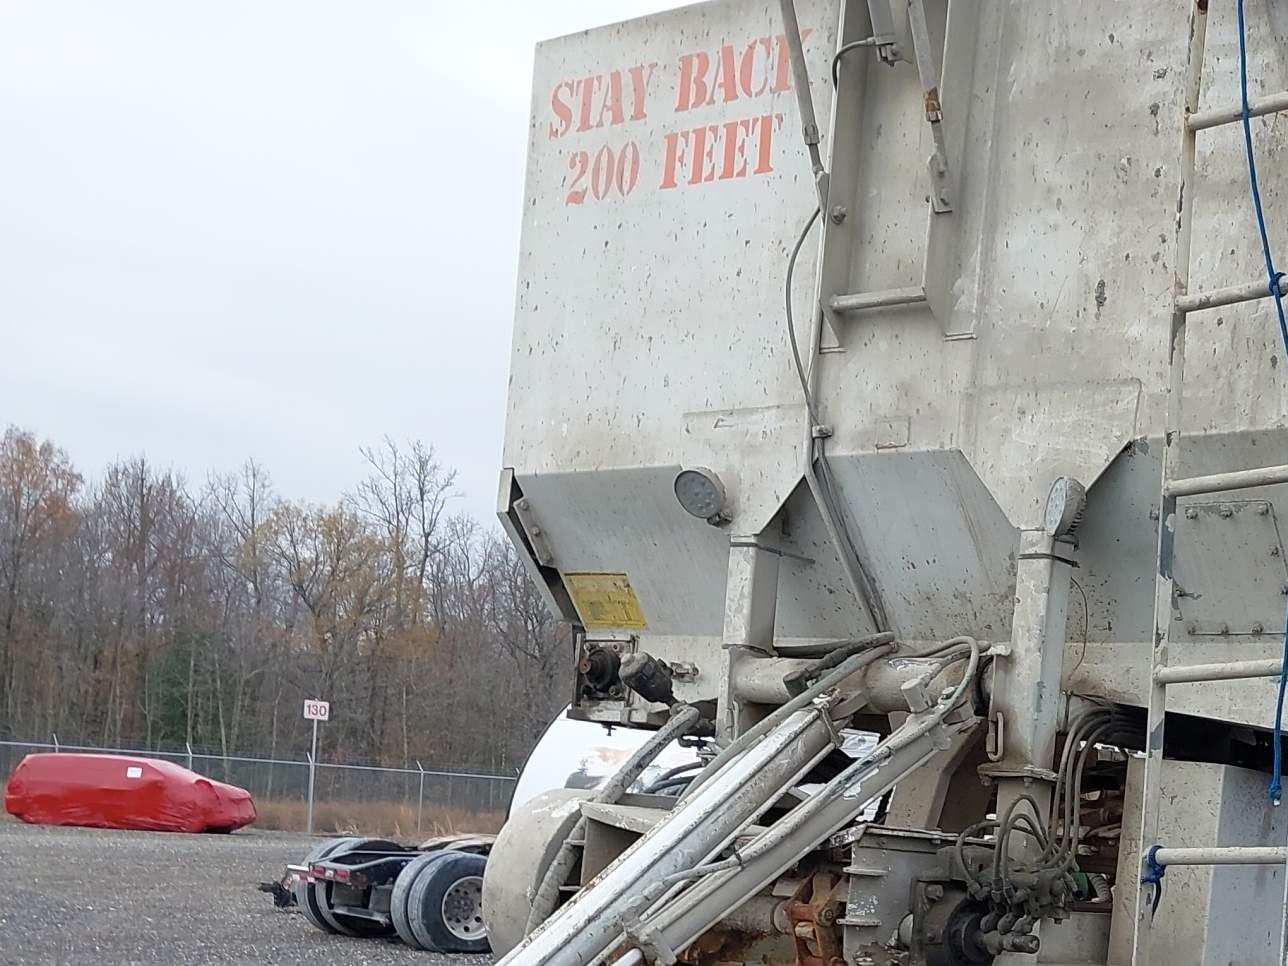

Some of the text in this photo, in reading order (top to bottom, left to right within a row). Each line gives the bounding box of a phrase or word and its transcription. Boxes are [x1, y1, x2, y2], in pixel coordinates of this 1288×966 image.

[548, 27, 814, 142] STAY BACK
[565, 112, 784, 206] 200 FEET
[307, 704, 327, 717] 130
